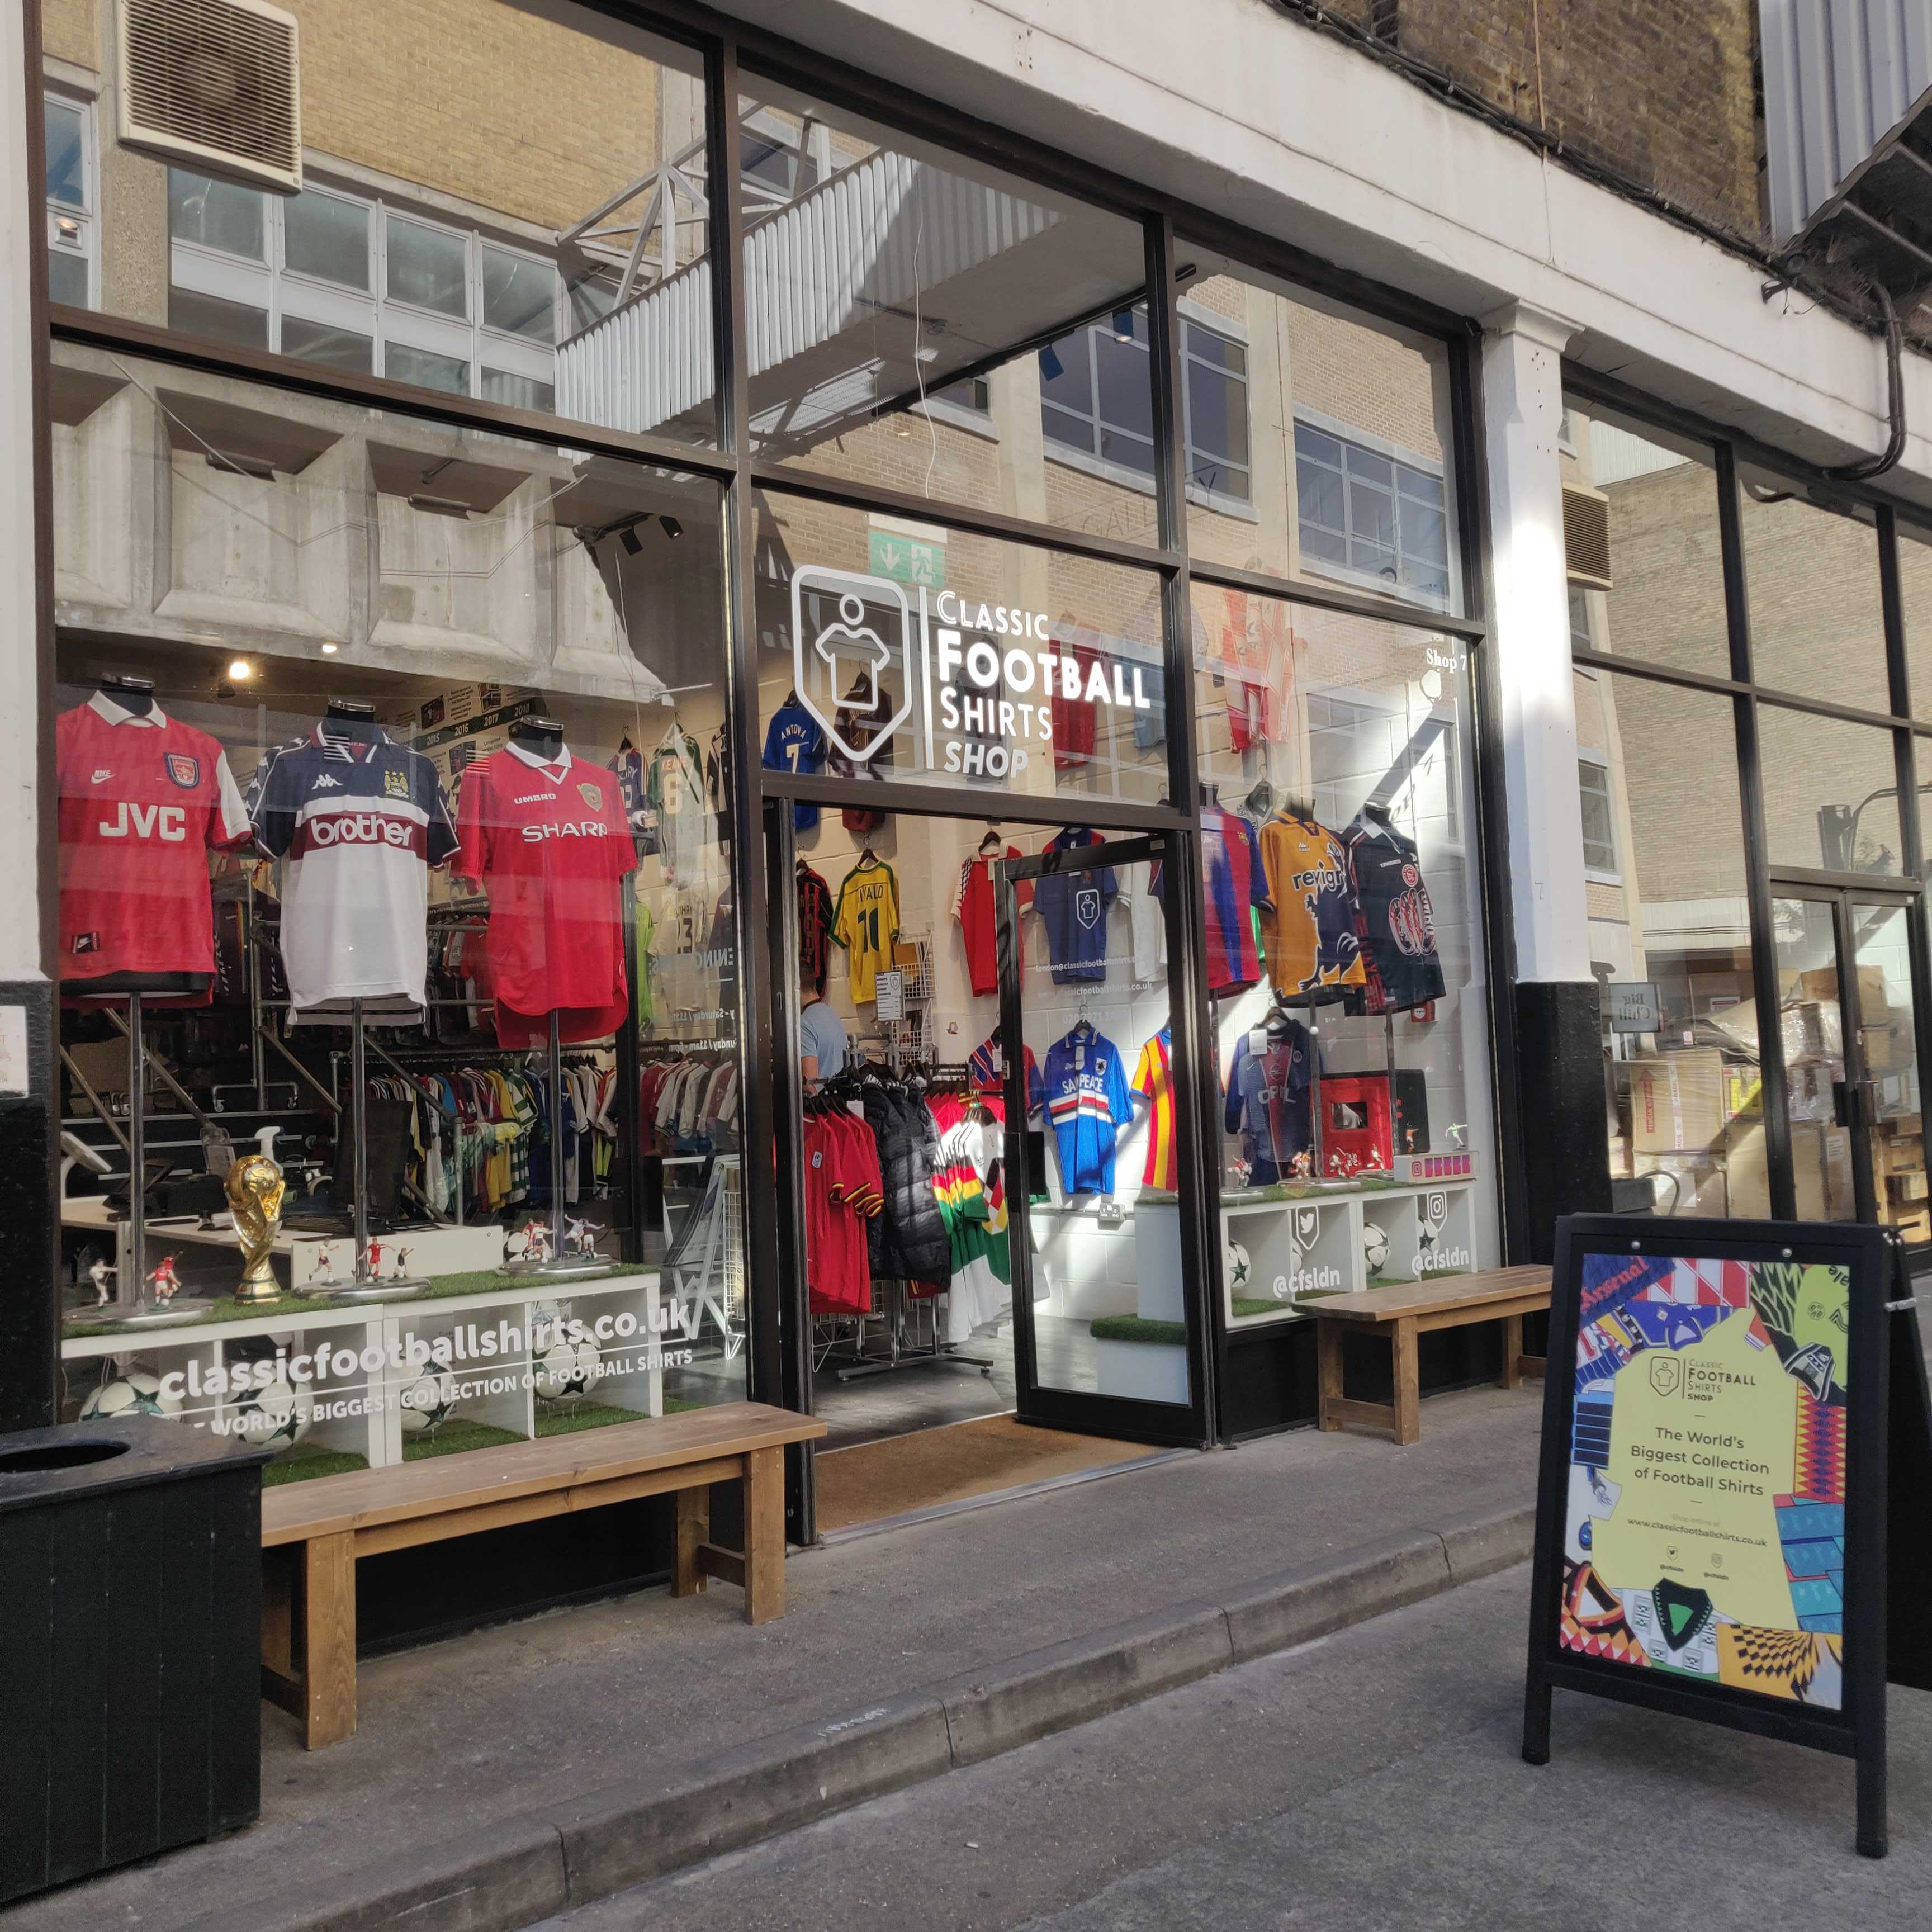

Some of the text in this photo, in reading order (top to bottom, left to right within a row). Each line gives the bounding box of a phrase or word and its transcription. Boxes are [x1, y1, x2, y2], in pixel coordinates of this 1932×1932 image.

[937, 590, 1049, 640] CLASSIC
[937, 629, 1150, 708] FOOTBALL
[1426, 648, 1467, 674] Shop 7
[940, 686, 1053, 740] SHIRTS
[427, 733, 440, 745] 2015
[454, 723, 468, 736] 2016
[484, 713, 499, 727] 2017
[787, 744, 799, 774] 7
[944, 741, 1028, 779] SHOP
[514, 793, 556, 804] UMBRO
[100, 802, 185, 841] JVC
[311, 815, 413, 846] brother
[522, 822, 608, 842] SHARP
[1412, 1247, 1469, 1276] @cfsldn
[1273, 1266, 1341, 1298] @cfsldn
[160, 1298, 690, 1400] classicfootballshirts.co.uk
[1689, 1359, 1723, 1370] CLASSIC
[1689, 1368, 1756, 1386] FOOTBALL
[211, 1407, 307, 1436] WORLD'S
[312, 1394, 397, 1423] BIGGEST
[401, 1375, 517, 1409] COLLECTION
[522, 1371, 544, 1389] OF
[549, 1360, 634, 1386] FOOTBALL
[637, 1349, 693, 1372] SHIRTS
[1688, 1381, 1722, 1393] SHIRTS
[1688, 1393, 1713, 1401] SHOP
[1655, 1427, 1744, 1449] The World's
[1631, 1445, 1769, 1475] Biggest Collection
[1635, 1467, 1764, 1496] of Football Shirts
[1627, 1518, 1767, 1547] www.classicfootballshirts.co.uk
